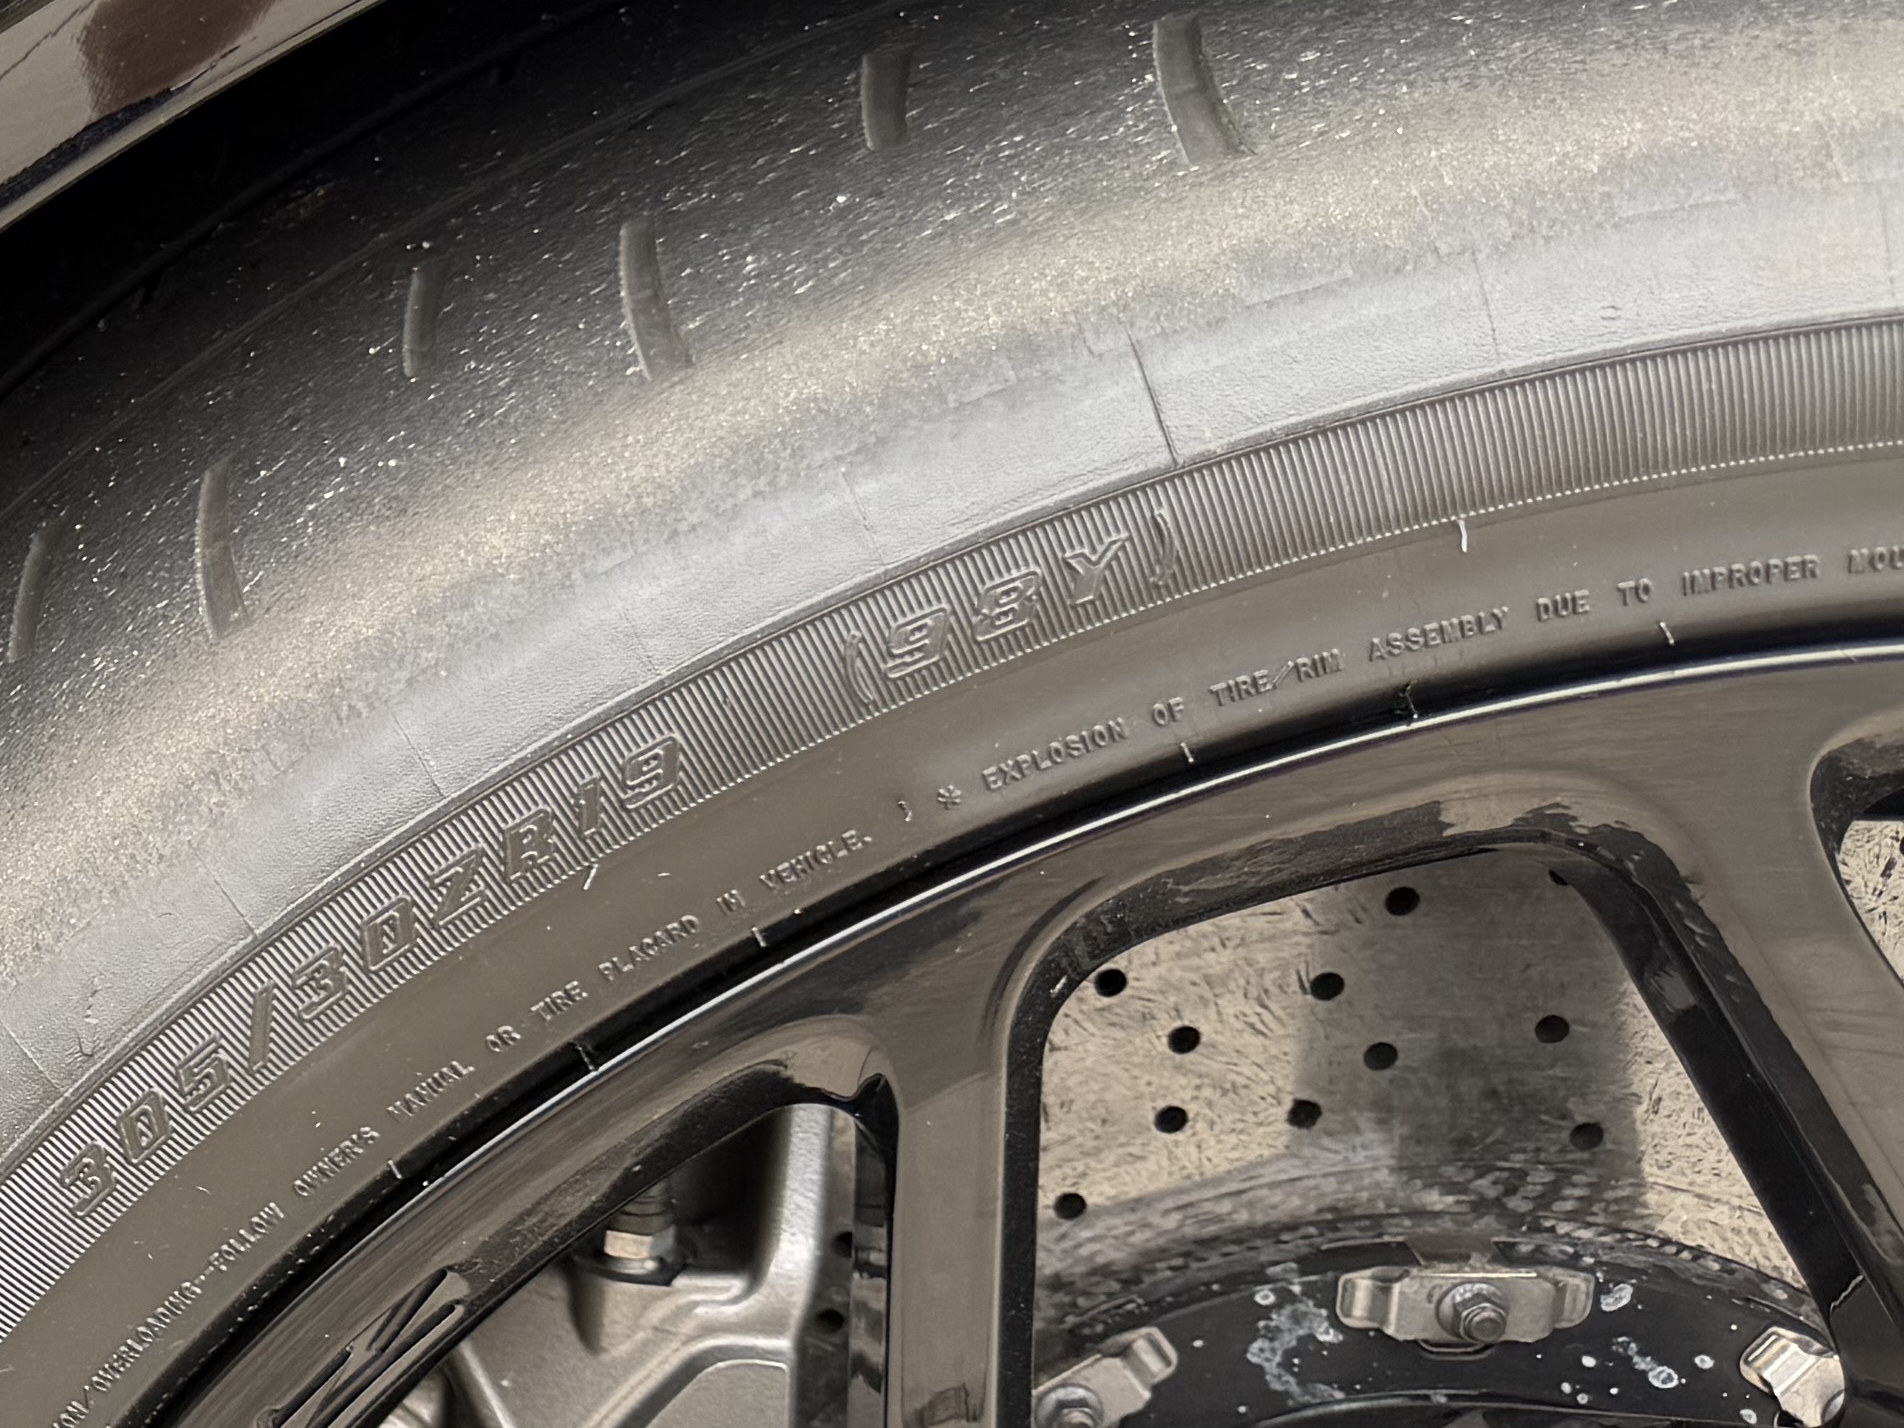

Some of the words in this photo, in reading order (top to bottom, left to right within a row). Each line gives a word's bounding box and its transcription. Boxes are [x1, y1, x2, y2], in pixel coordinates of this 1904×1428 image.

[979, 716, 1130, 792] EXPLOSION
[1150, 696, 1187, 727] OF
[1368, 606, 1511, 662] ASSEMBLY
[1533, 591, 1591, 622] DUE
[1616, 578, 1652, 606] TO
[1681, 554, 1820, 596] IMPROPER
[60, 734, 682, 1219] 305/30ZR19
[843, 509, 1177, 705] (98Y)
[387, 1060, 475, 1117] MANUAL
[486, 1025, 522, 1052] OR
[530, 980, 588, 1020] TIRE
[598, 914, 699, 980] PLACARD
[716, 889, 746, 911] IN
